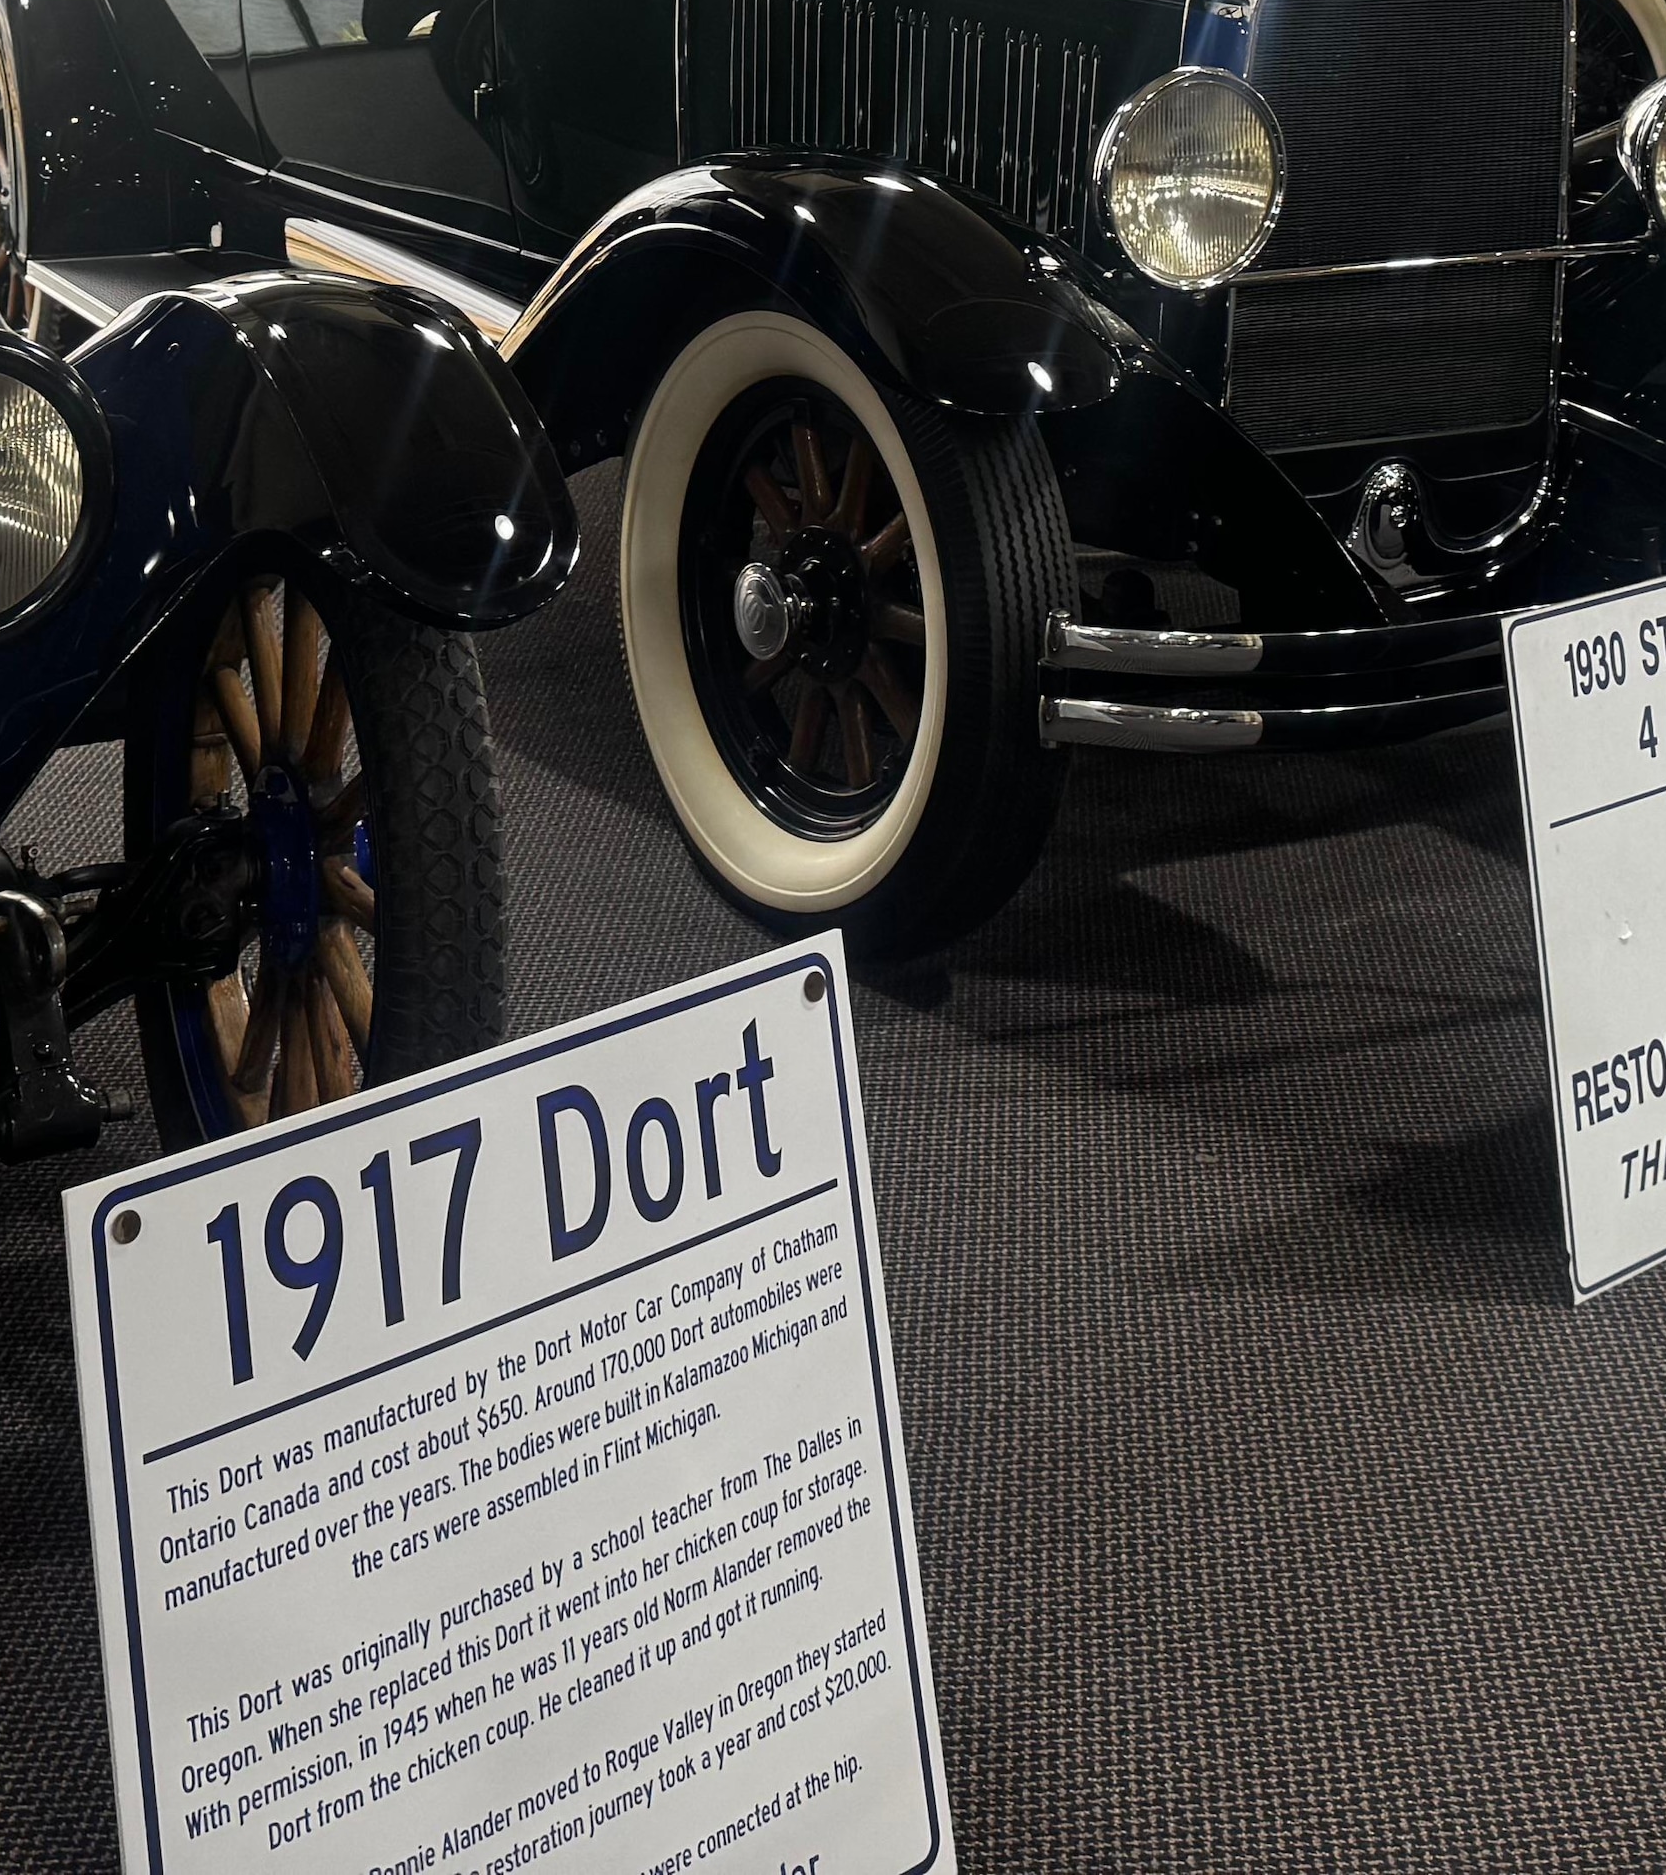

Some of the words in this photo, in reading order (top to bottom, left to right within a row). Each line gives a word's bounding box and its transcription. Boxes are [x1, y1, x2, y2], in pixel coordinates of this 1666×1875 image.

[1564, 632, 1626, 698] 1930
[1639, 706, 1658, 758] 4
[206, 1119, 483, 1387] 1917
[536, 1017, 783, 1262] Dort
[159, 1514, 237, 1565] Ontario
[243, 1481, 321, 1532] Canada
[327, 1458, 365, 1498] and
[370, 1440, 411, 1480] cost
[416, 1415, 471, 1461] about
[476, 1393, 529, 1439] $650.
[534, 1361, 597, 1413] Around
[599, 1332, 667, 1383] 170,000
[669, 1315, 706, 1353] Dort
[709, 1278, 803, 1336] automobiles
[804, 1260, 843, 1293] were
[163, 1526, 311, 1613] manufactured
[313, 1511, 360, 1549] over
[362, 1498, 395, 1529] the
[397, 1474, 457, 1523] years.
[457, 1457, 493, 1488] The
[495, 1429, 556, 1473] bodies
[556, 1409, 602, 1446] were
[603, 1385, 643, 1426] built
[643, 1381, 662, 1408] in
[661, 1344, 750, 1400] Kalamazoo
[750, 1313, 819, 1360] Michigan
[820, 1293, 849, 1328] and
[165, 1477, 210, 1515] This
[218, 1453, 264, 1496] Dort
[271, 1439, 315, 1474] was
[322, 1375, 458, 1454] manufactured
[464, 1367, 489, 1401] by
[496, 1353, 528, 1383] the
[534, 1328, 573, 1368] Dort
[578, 1310, 629, 1349] Motor
[634, 1295, 664, 1325] Car
[669, 1261, 744, 1310] Company
[750, 1245, 767, 1276] of
[772, 1221, 839, 1266] Chatham
[350, 1548, 385, 1580] the
[389, 1528, 430, 1564] cars
[432, 1506, 482, 1544] were
[485, 1456, 580, 1521] assembled
[581, 1451, 601, 1479] in
[602, 1429, 643, 1470] Flint
[644, 1401, 722, 1451] Michigan.
[440, 1805, 514, 1861] Alander
[517, 1766, 580, 1822] moved
[581, 1761, 602, 1789] to
[604, 1733, 660, 1778] Rogue
[661, 1702, 715, 1746] Valley
[716, 1692, 735, 1719] in
[736, 1663, 795, 1708] Oregon
[795, 1641, 831, 1677] they
[833, 1606, 887, 1657] started
[485, 1815, 586, 1875] restoration
[587, 1777, 655, 1840] journey
[657, 1753, 698, 1794] took
[700, 1749, 713, 1771] a
[714, 1726, 753, 1772] year
[755, 1702, 787, 1741] and
[788, 1684, 823, 1723] cost
[823, 1648, 893, 1707] $20,000.
[647, 1847, 694, 1875] were
[696, 1791, 783, 1860] connected
[784, 1780, 803, 1811] at
[803, 1770, 831, 1800] the
[832, 1753, 864, 1785] hip.
